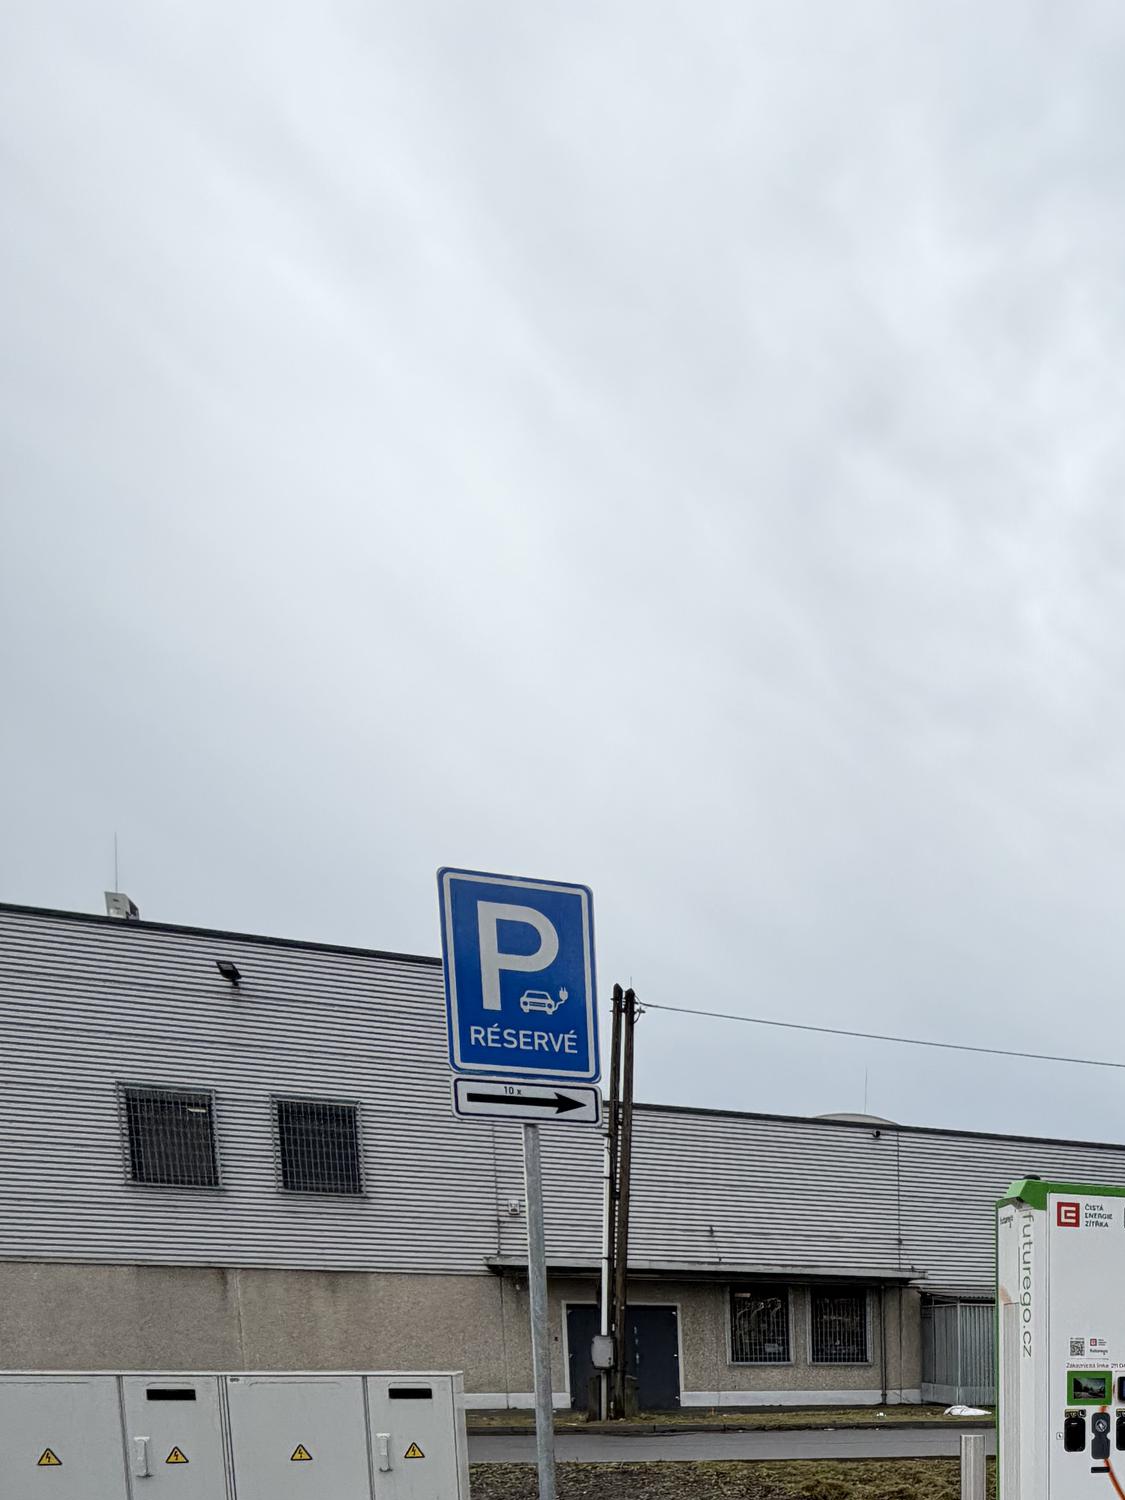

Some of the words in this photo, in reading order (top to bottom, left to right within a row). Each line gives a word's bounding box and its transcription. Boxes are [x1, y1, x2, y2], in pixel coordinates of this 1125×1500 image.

[477, 900, 559, 1011] P
[470, 1023, 578, 1054] RÉSERVÉ
[504, 1086, 514, 1095] 10
[1020, 1211, 1034, 1359] futurego.cz
